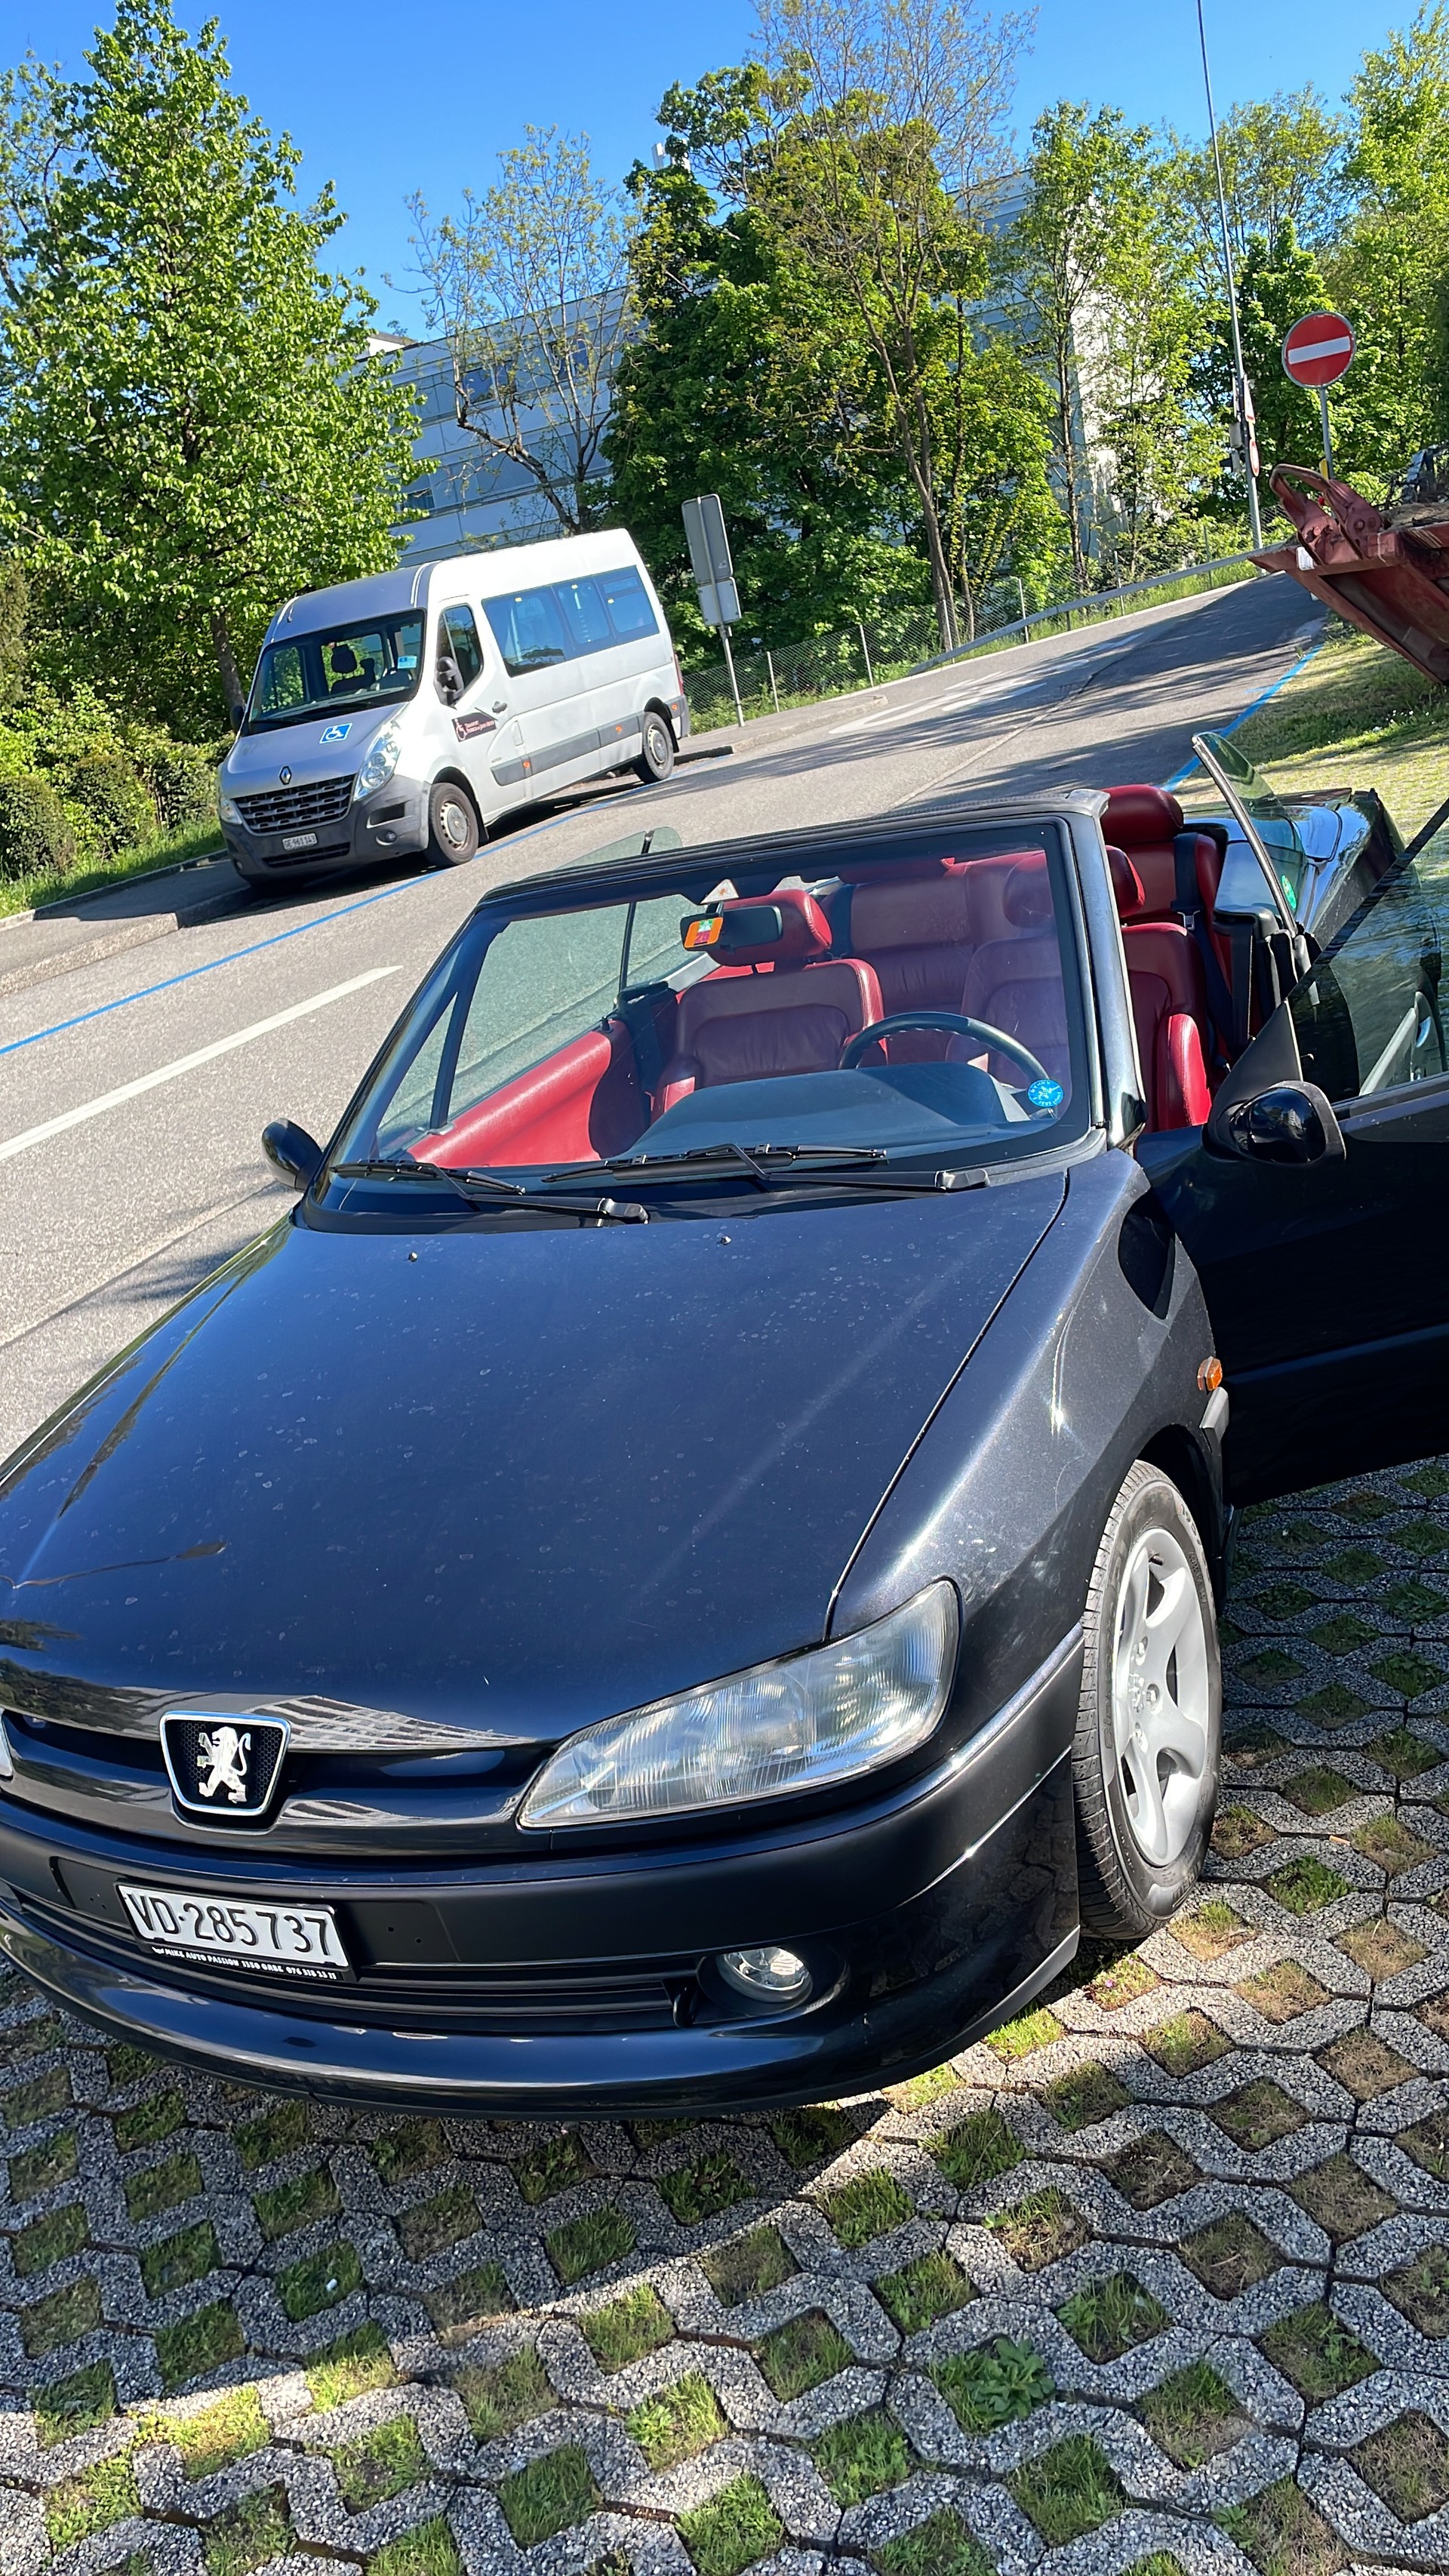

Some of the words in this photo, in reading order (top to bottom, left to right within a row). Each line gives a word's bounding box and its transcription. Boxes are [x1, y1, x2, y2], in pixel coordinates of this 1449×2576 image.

[165, 1948, 185, 1958] MIKE
[186, 1952, 207, 1962] AUTO
[207, 1955, 240, 1966] PASSION
[241, 1960, 260, 1970] 1350
[261, 1963, 285, 1973] ORBE
[285, 1966, 303, 1975] 076
